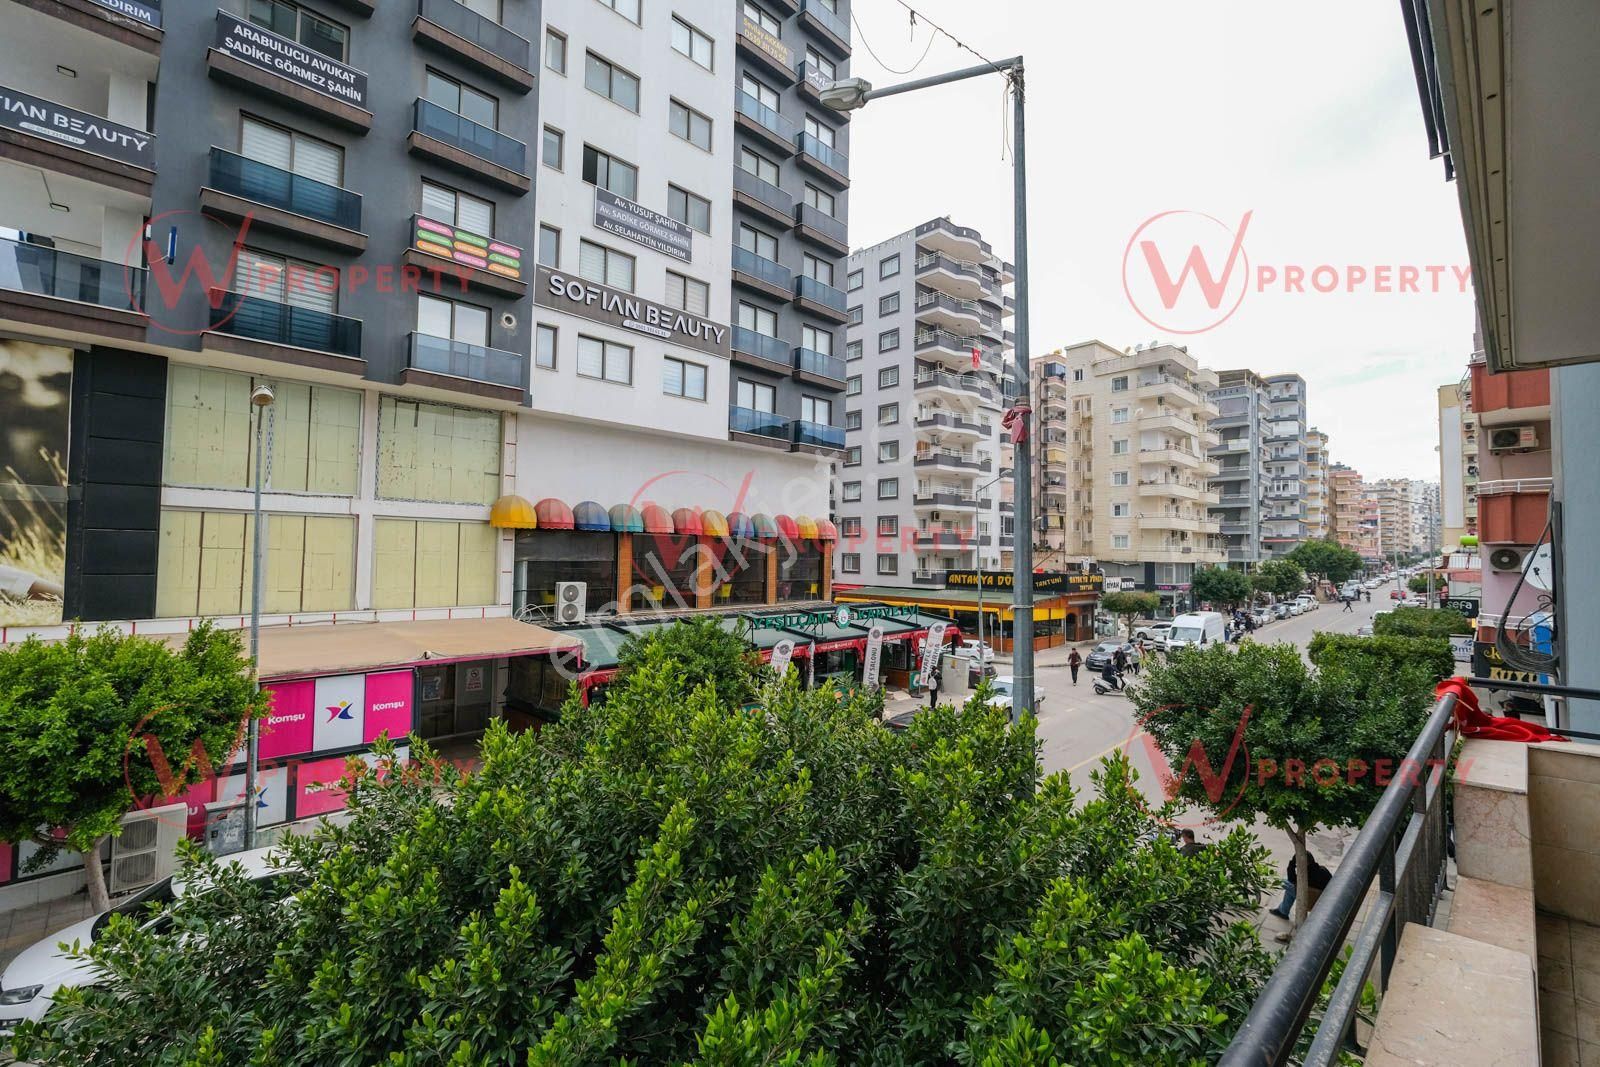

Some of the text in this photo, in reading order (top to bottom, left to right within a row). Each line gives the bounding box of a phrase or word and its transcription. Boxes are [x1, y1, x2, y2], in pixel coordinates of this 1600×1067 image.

[102, 0, 152, 21] DIRIM
[225, 36, 361, 102] SADİKE GÖRMEZ ŞAHİN
[233, 24, 356, 84] ARABULUCU AVUKAT
[54, 112, 148, 152] BEAUTY
[600, 205, 689, 248] Av. SADİKE GÖRMEZ ŞAHİN
[614, 197, 678, 231] Av. YUSUF ŞAHİN
[603, 220, 686, 259] Av. SELAHATTİN YILDIRIM
[549, 274, 725, 344] SOFIAN BEAUTY
[948, 573, 1015, 586] ANTAKYA DÖ
[267, 712, 306, 725] Komşu
[373, 701, 405, 712] Komşu
